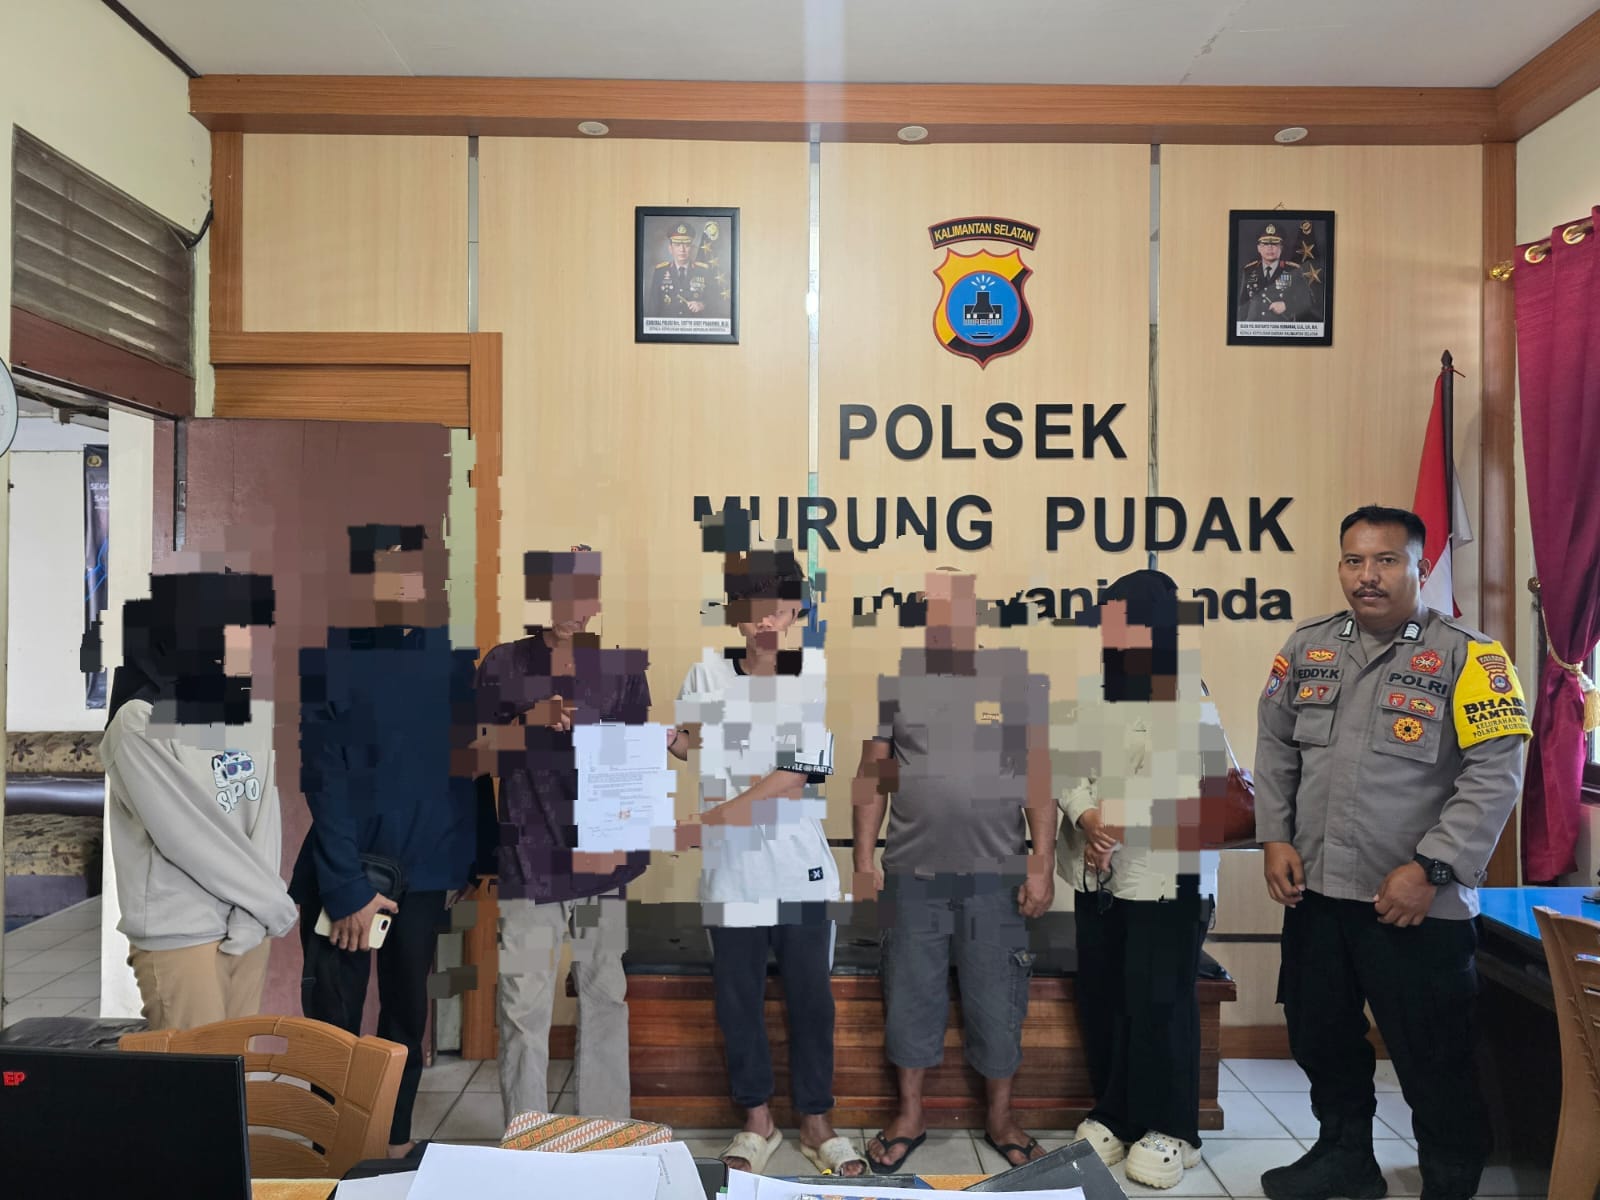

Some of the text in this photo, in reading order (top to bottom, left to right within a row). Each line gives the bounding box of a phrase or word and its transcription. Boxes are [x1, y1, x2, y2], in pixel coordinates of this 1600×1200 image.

[934, 223, 1034, 243] KALIMANTAN SELATAN
[839, 402, 1127, 460] POLSEK
[1045, 496, 1295, 552] PUDAK
[1192, 577, 1293, 620] nda
[1298, 668, 1340, 680] EDDY.K
[1389, 672, 1448, 695] POLRI
